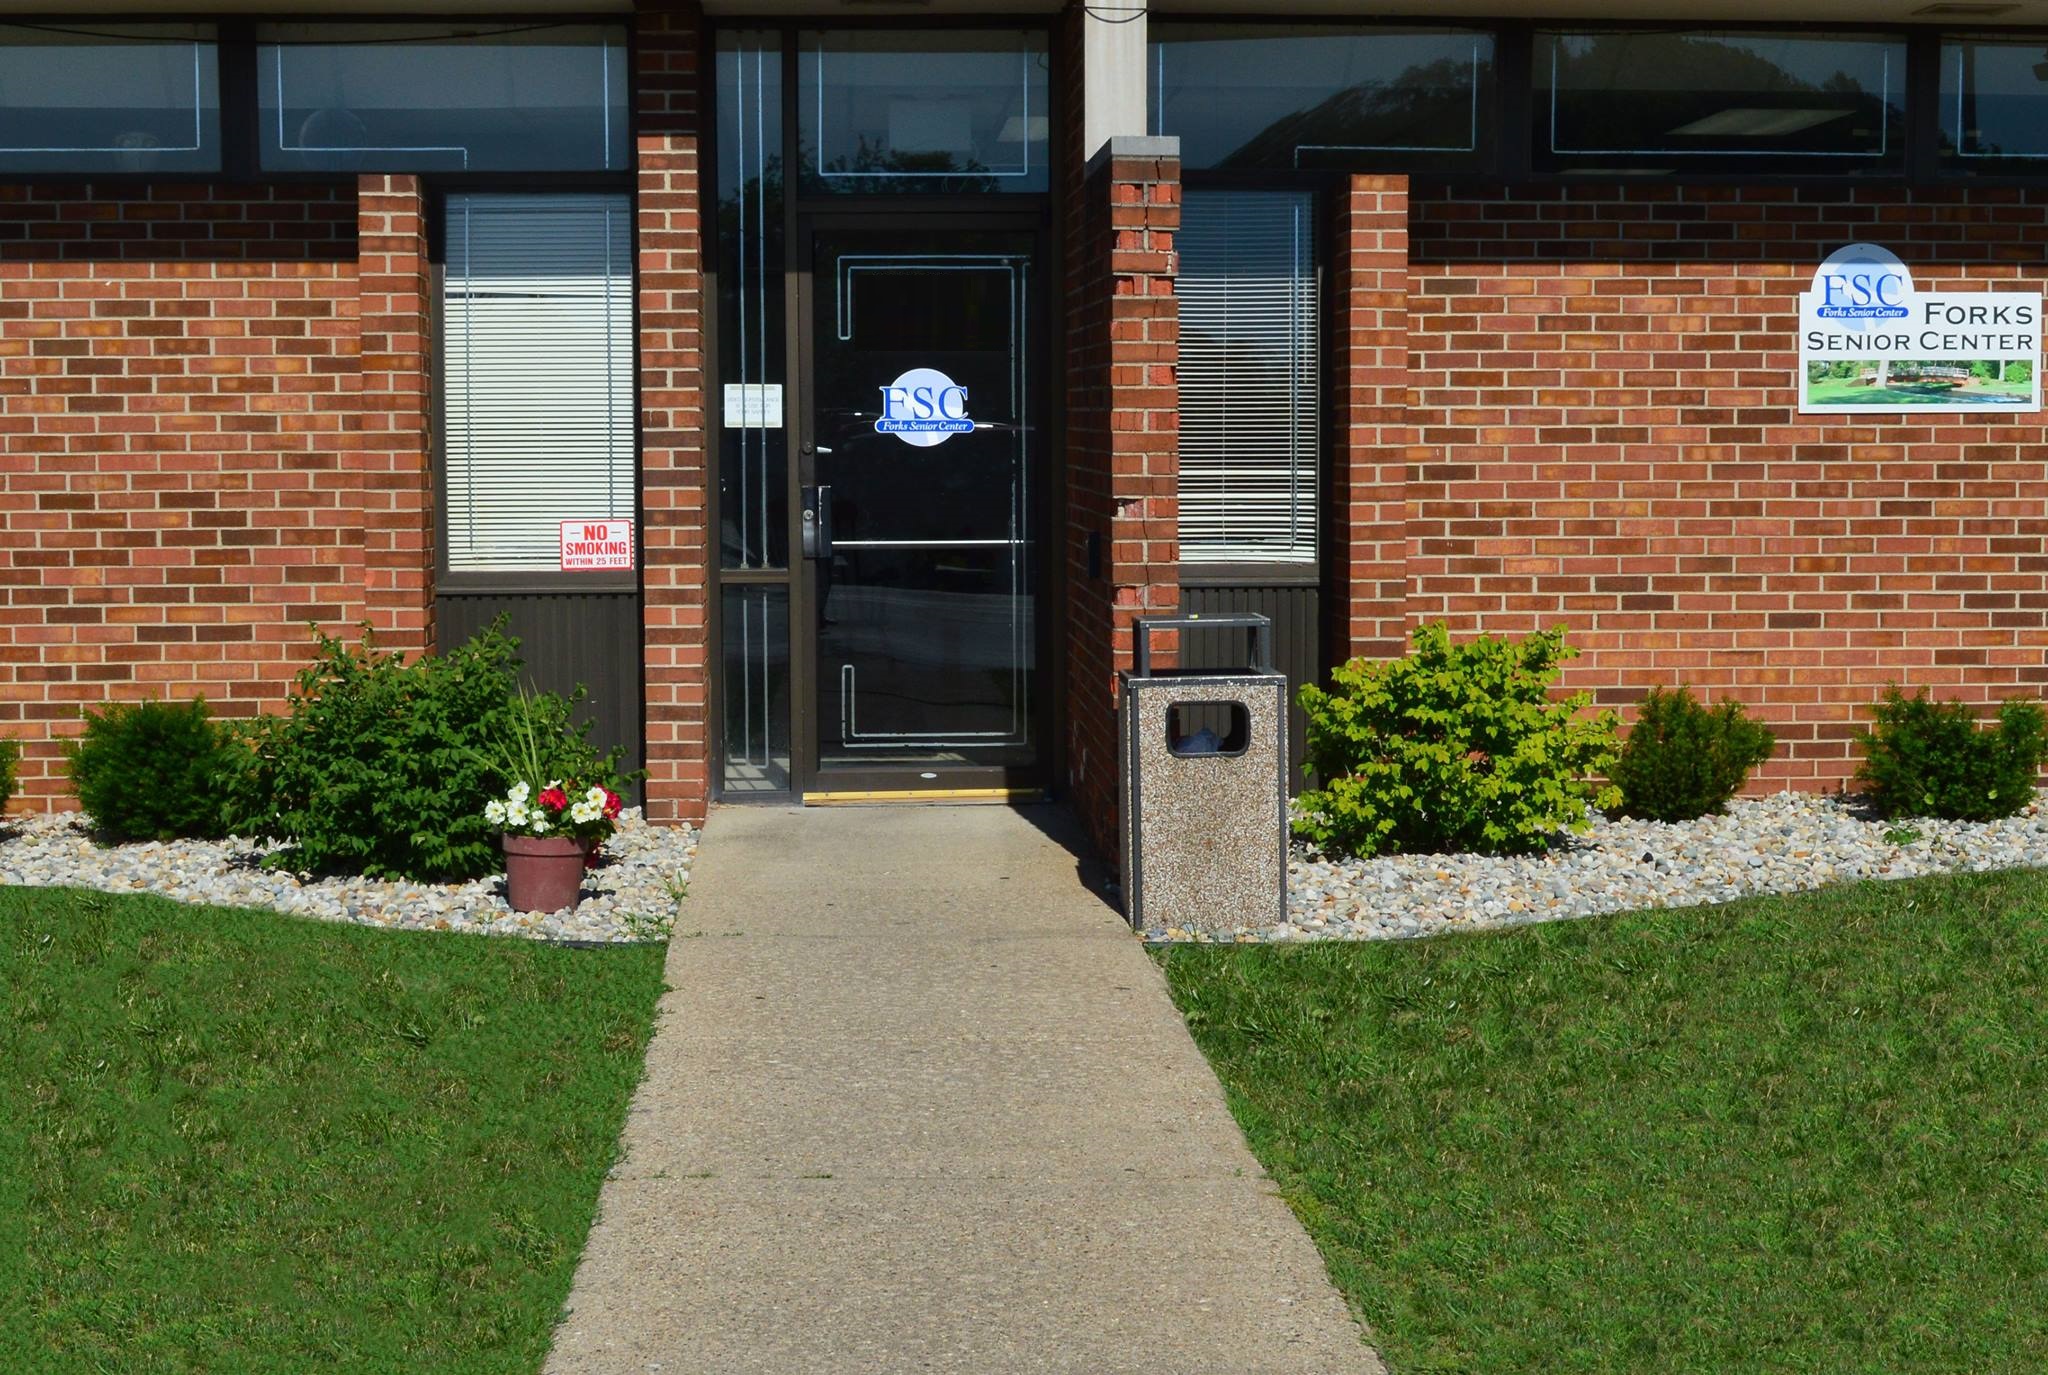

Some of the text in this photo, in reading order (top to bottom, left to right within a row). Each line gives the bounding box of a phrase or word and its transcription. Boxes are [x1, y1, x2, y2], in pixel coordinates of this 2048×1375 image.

[1821, 274, 1904, 306] FSC
[1823, 307, 1904, 317] Forks Senior Center
[1924, 302, 2033, 325] FORKS
[1807, 331, 2033, 351] SENIOR CENTER
[880, 386, 968, 420] FSC
[883, 421, 968, 431] Forks Senior Center
[583, 524, 608, 541] NO
[565, 541, 627, 556] SMOKING
[565, 556, 628, 566] WITHIN 25 FEET
